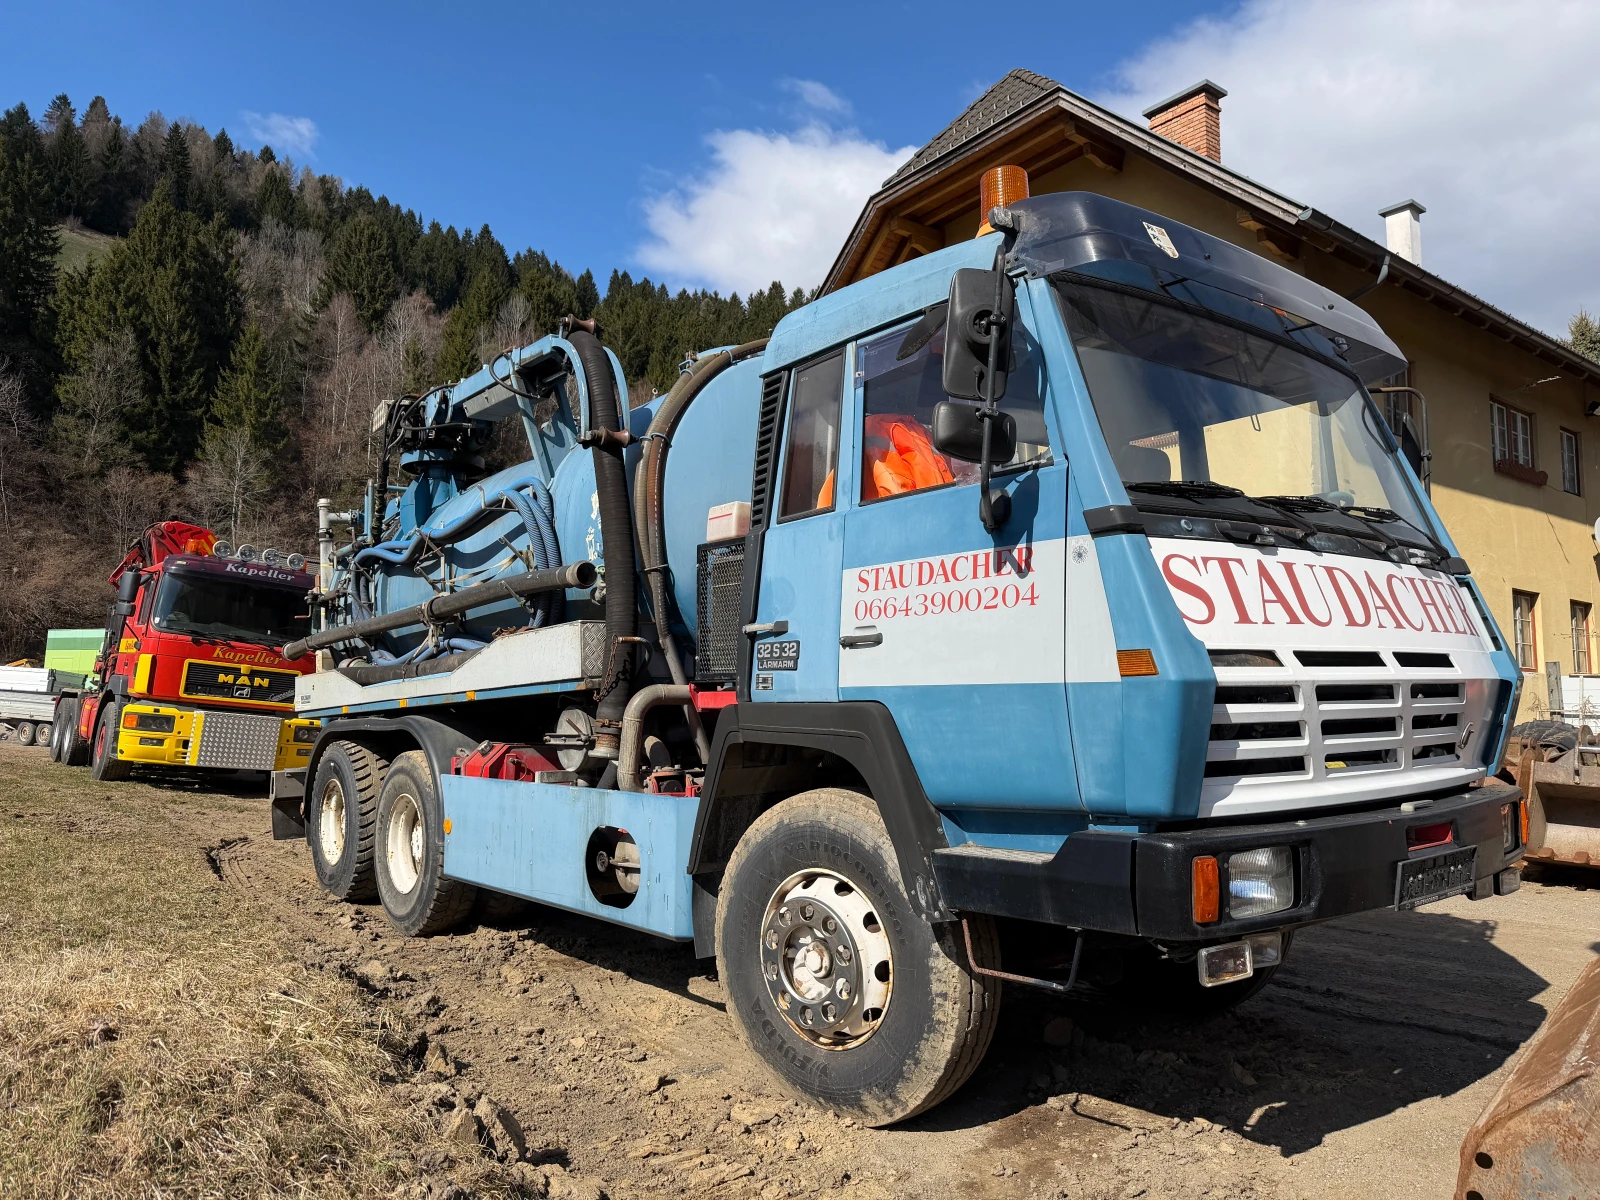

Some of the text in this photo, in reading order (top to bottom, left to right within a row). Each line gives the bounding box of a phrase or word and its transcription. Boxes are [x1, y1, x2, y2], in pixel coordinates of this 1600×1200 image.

[225, 563, 296, 581] Kapeller
[857, 546, 1036, 594] STAUDACHER
[854, 581, 1041, 622] 06643900204
[1161, 553, 1481, 638] STAUDACHER
[212, 647, 284, 665] Kapeller
[758, 642, 797, 658] 32 S 32
[758, 660, 795, 669] LÄRMARM
[218, 674, 270, 688] MAN
